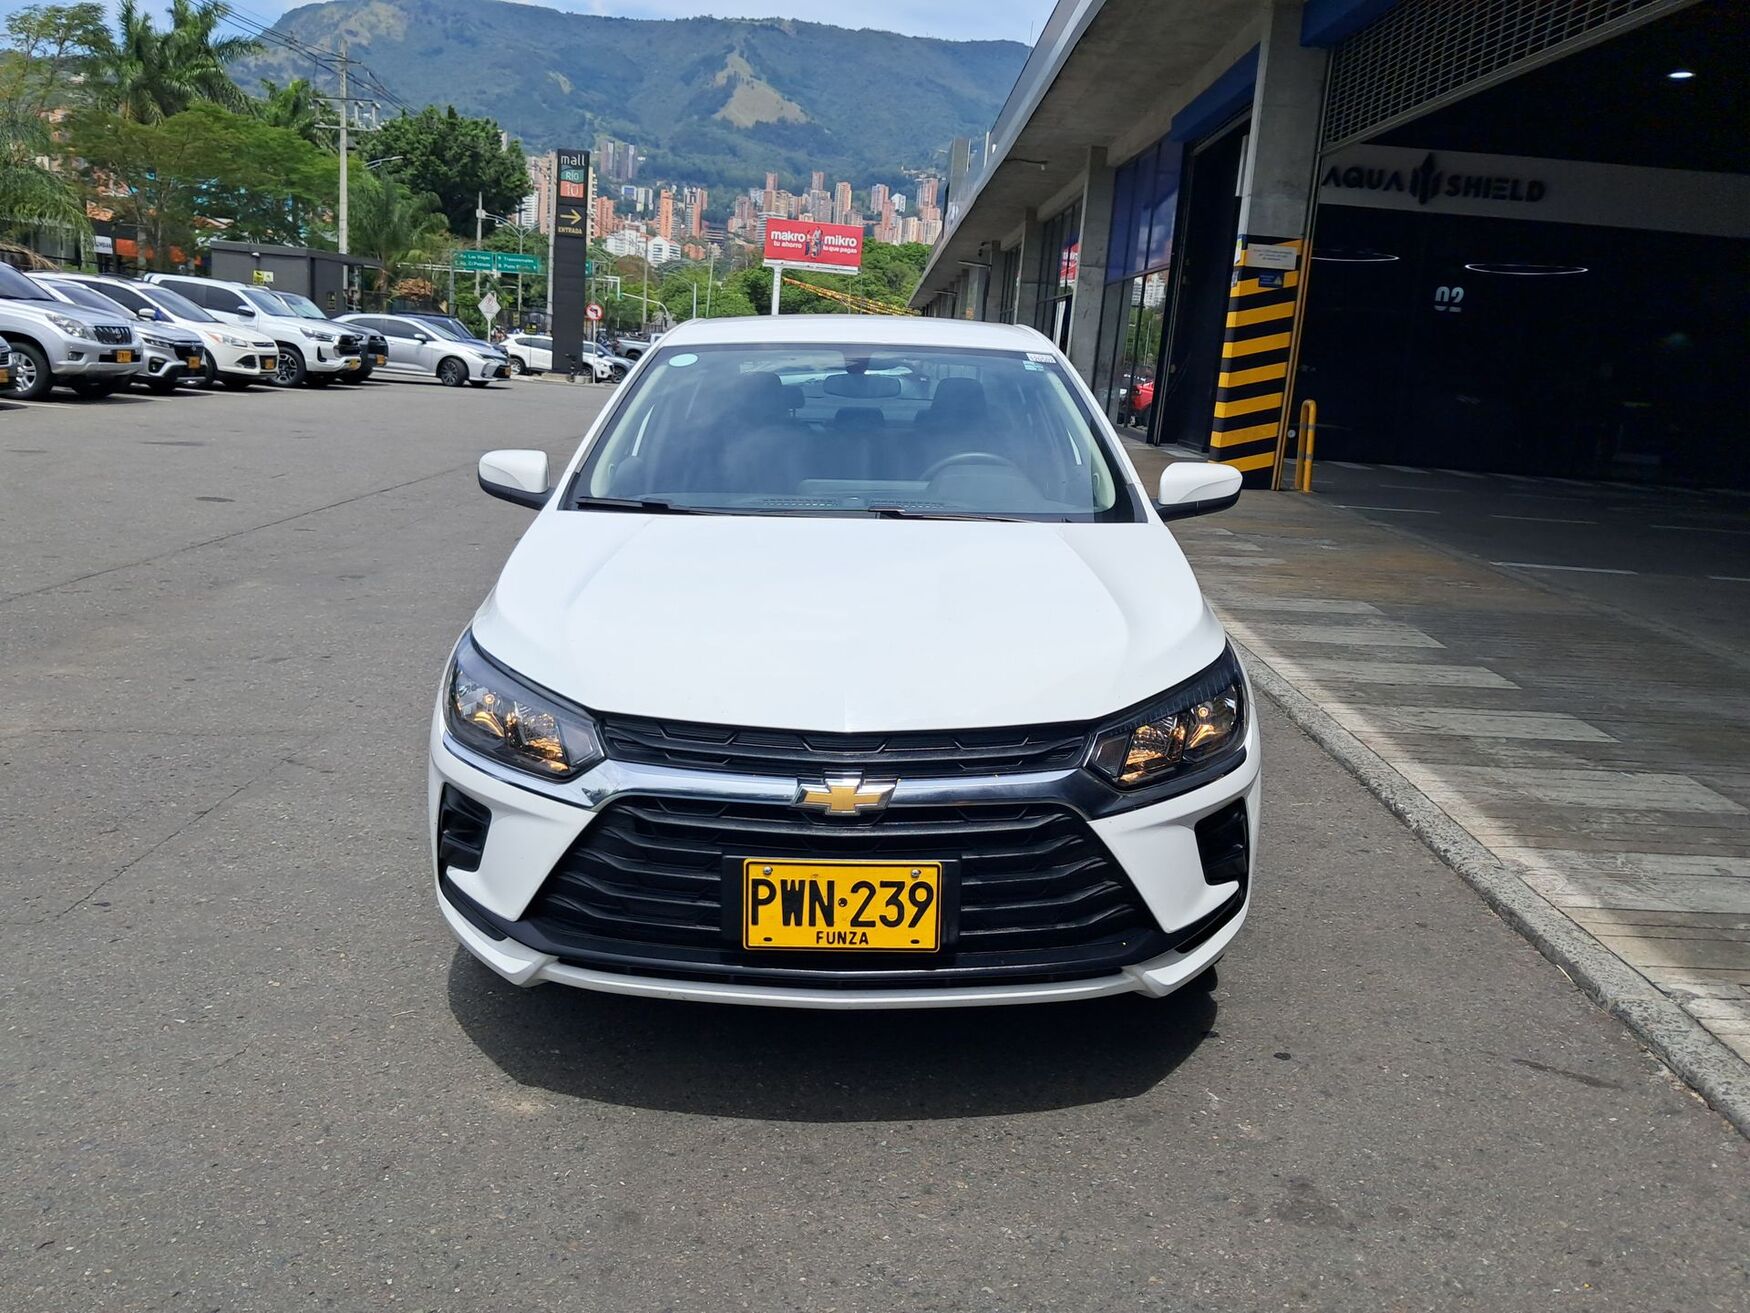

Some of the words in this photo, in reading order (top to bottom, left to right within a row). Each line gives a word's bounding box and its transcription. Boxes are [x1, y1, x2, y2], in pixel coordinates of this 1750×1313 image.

[561, 154, 585, 166] mall
[1321, 165, 1406, 192] AQUA
[1444, 175, 1547, 202] SHIELD
[566, 184, 579, 196] 10
[558, 226, 583, 234] ENTRADA
[770, 230, 806, 242] makro
[781, 240, 802, 249] ahorro
[824, 235, 857, 247] mikro
[1434, 286, 1465, 313] 02
[815, 930, 870, 945] FUNZA
